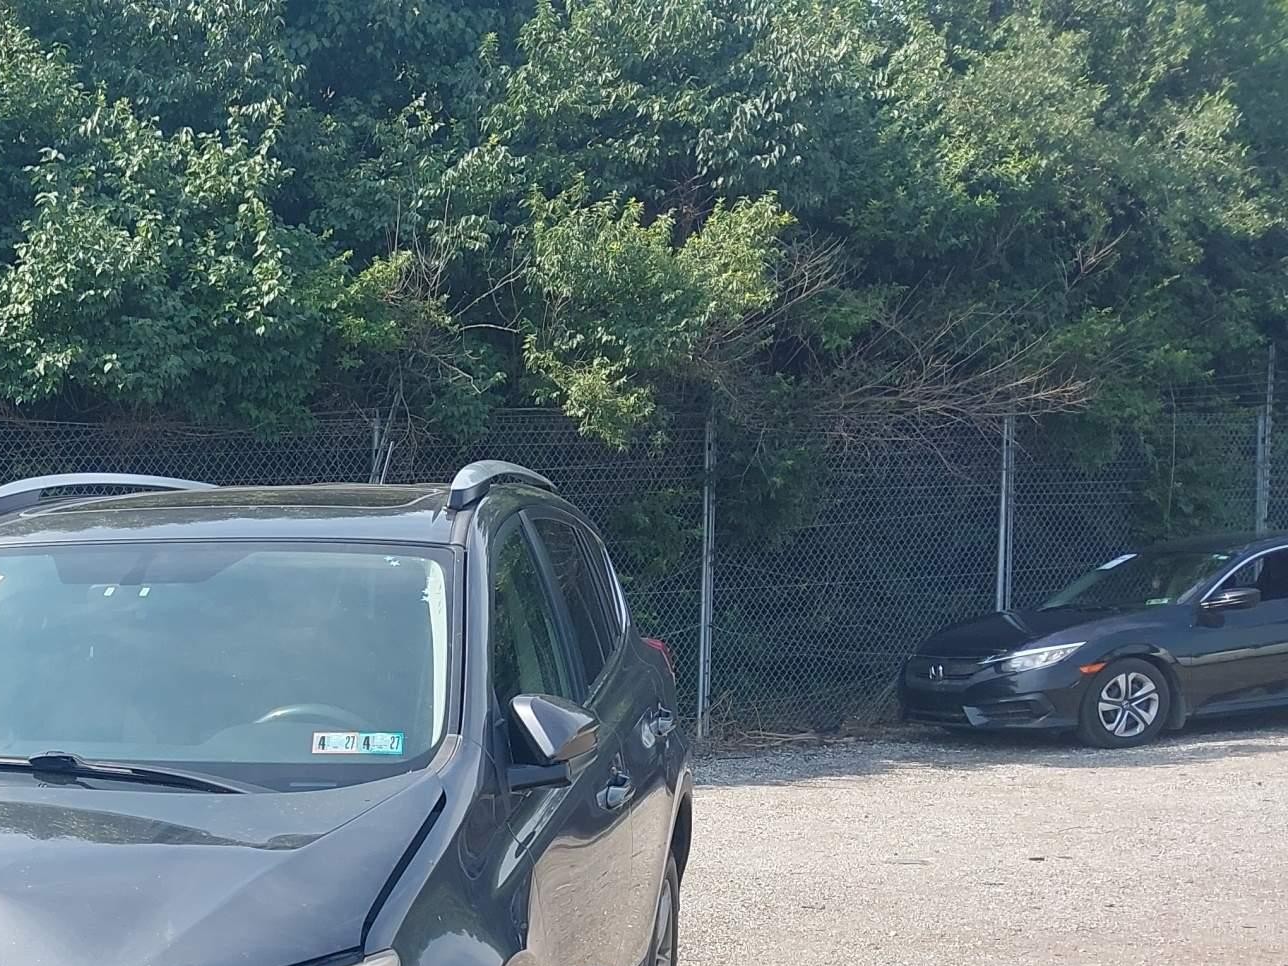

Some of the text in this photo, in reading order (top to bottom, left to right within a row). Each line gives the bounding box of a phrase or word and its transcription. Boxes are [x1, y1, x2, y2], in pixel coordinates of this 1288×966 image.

[318, 735, 326, 751] 4
[344, 735, 356, 750] 27
[362, 735, 371, 751] 4
[389, 735, 400, 750] 27
